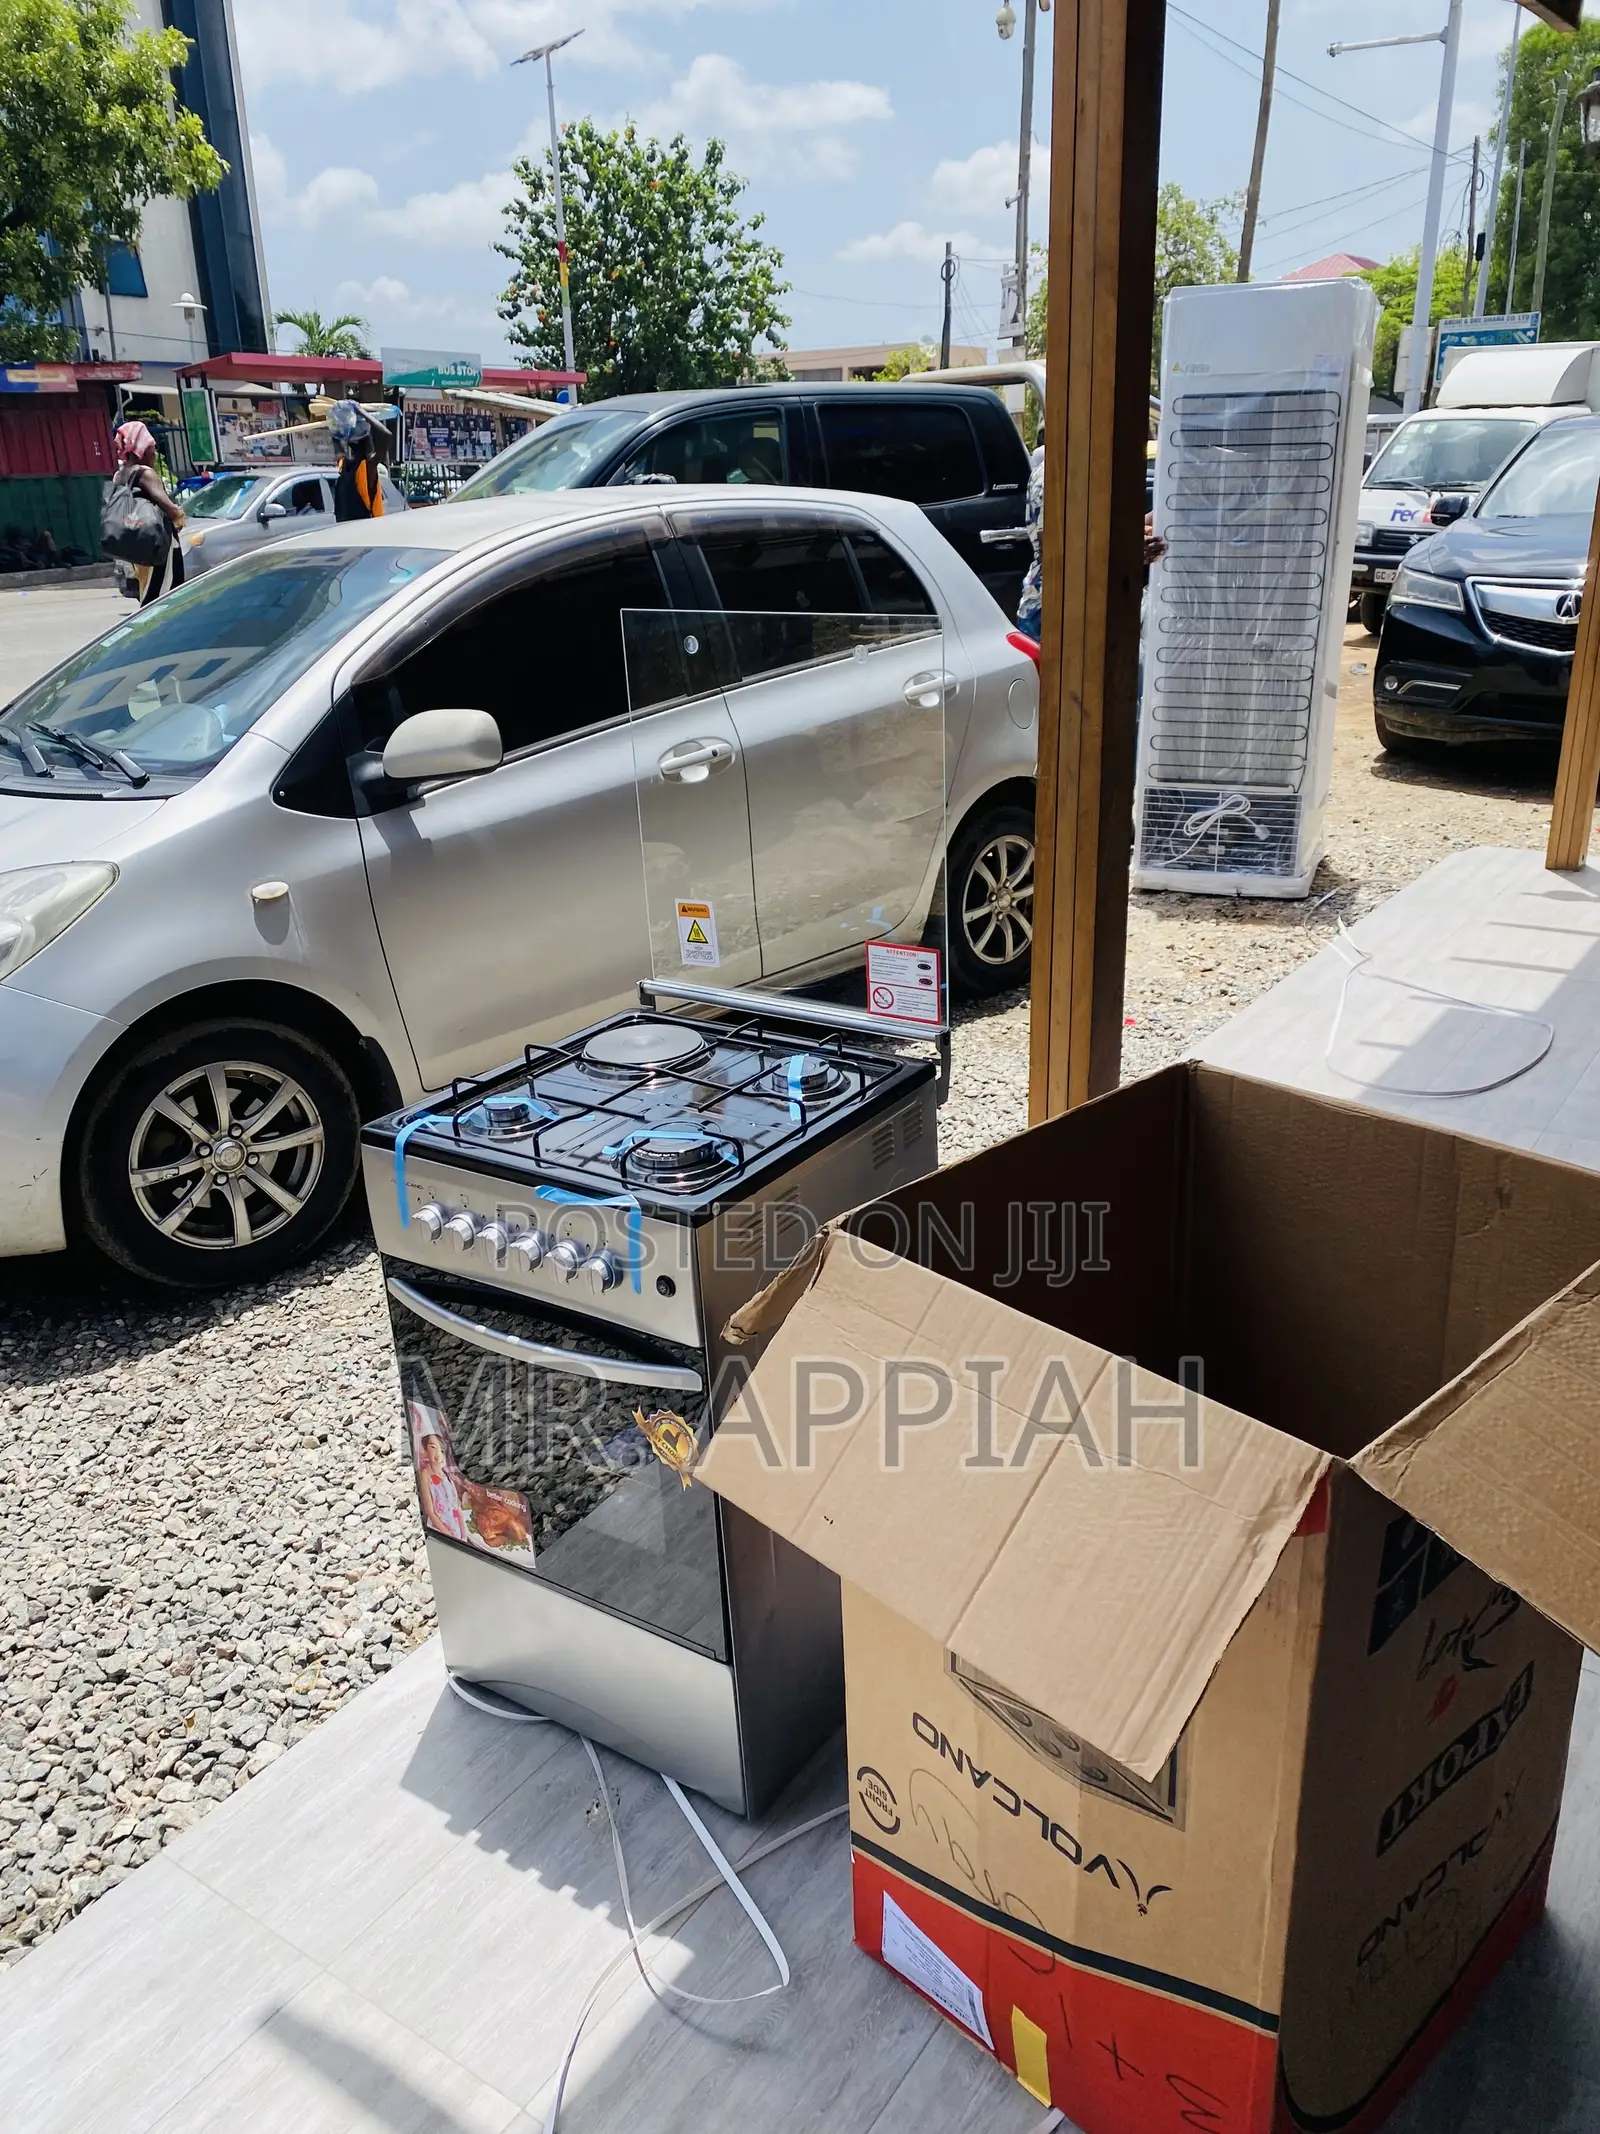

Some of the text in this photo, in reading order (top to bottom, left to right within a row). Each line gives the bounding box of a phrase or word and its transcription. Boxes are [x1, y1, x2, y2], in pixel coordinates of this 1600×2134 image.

[437, 365, 456, 375] BUS
[504, 1497, 527, 1513] cooking
[1379, 1664, 1532, 1855] EXPORT
[864, 1787, 893, 1817] FRONT
[867, 1779, 888, 1801] SIDE
[911, 1711, 1122, 1891] VOLCANO
